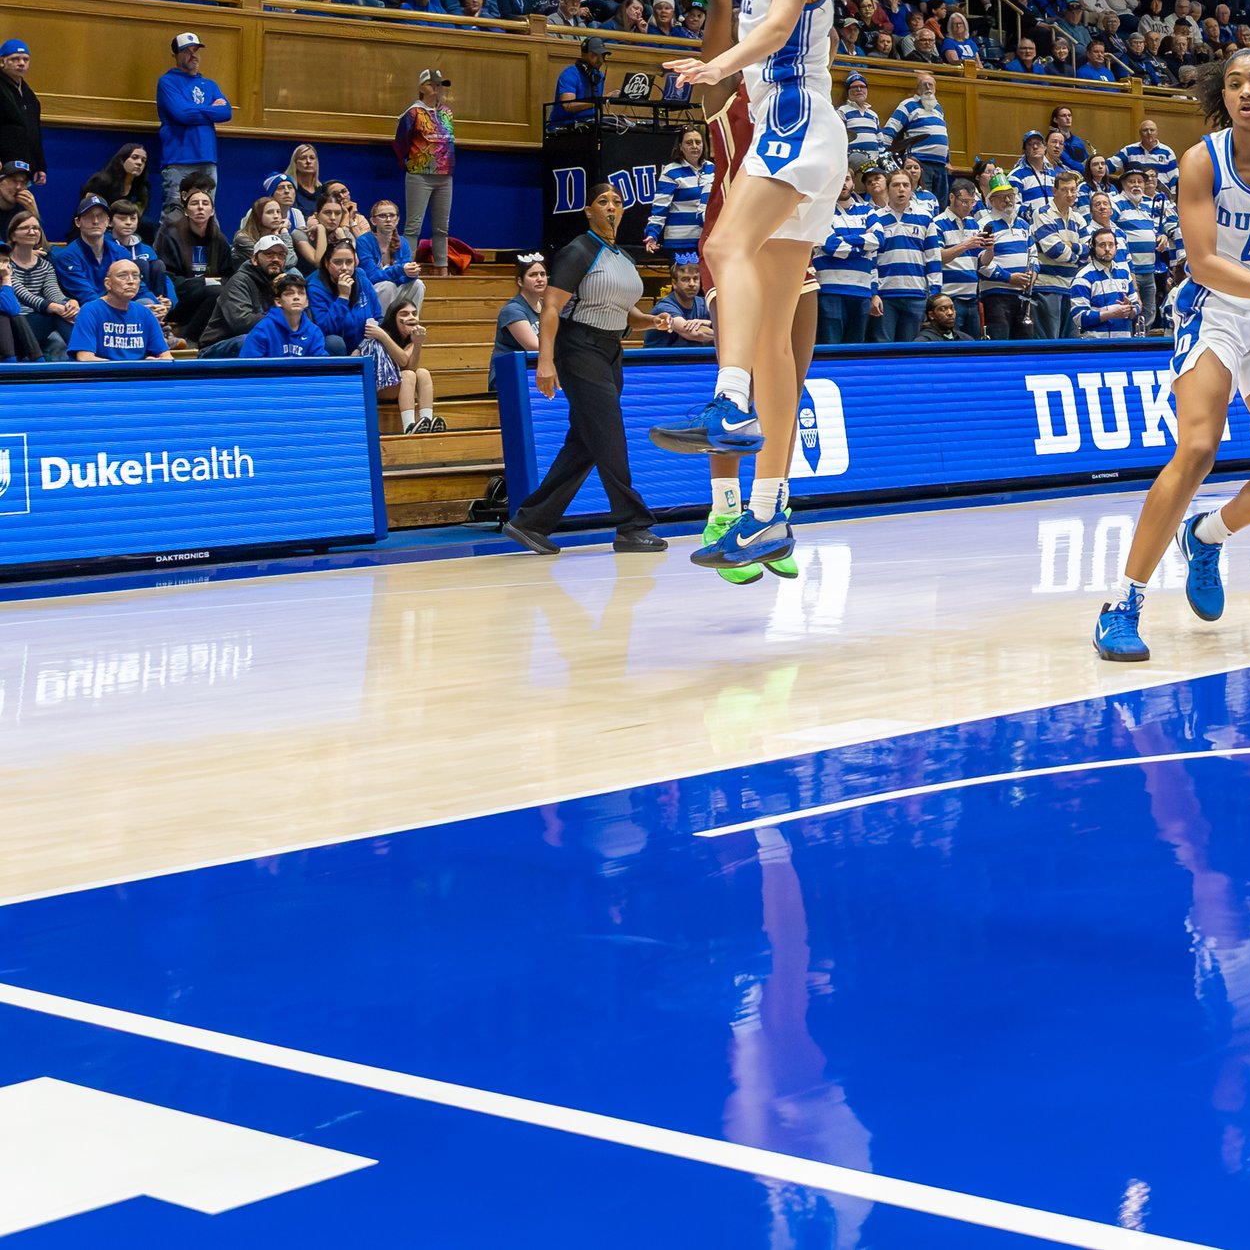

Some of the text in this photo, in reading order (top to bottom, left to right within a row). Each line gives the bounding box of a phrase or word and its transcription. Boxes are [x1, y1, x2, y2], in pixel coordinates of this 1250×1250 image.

[764, 140, 791, 159] D
[552, 166, 587, 215] D
[103, 335, 144, 348] CAROLINA
[1025, 370, 1231, 455] DUK
[40, 444, 255, 490] DukeHealth
[155, 551, 210, 563] DAKTRONICS
